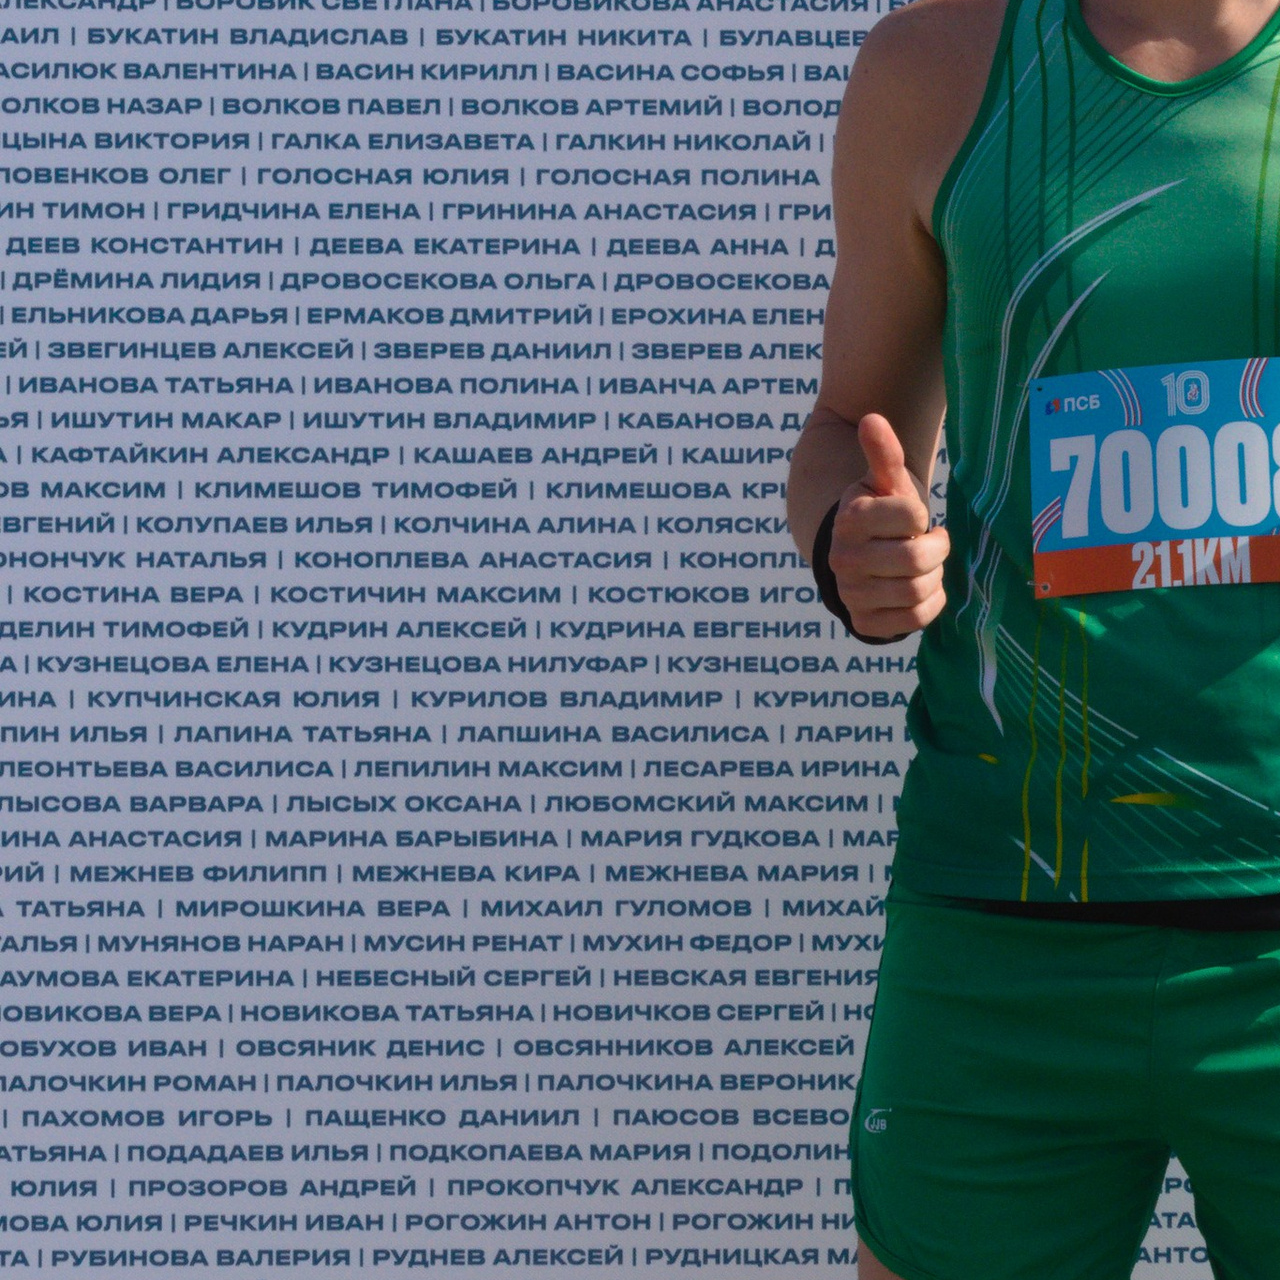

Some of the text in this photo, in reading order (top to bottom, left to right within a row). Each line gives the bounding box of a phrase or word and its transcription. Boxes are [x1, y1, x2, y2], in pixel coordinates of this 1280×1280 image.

[88, 28, 408, 47] БУКАТИН ВЛАДИСЛАВ
[223, 98, 440, 115] ВОЛКОВ ПАВЕЛ
[258, 168, 508, 185] ГОЛОСНАЯ ЮЛИЯ
[310, 238, 580, 256] ДЕЕВА ЕКАТЕРИНА
[13, 269, 154, 291] ДРЁМИНА
[161, 273, 260, 291] ЛИДИЯ
[308, 304, 592, 326] ЕРМАКОВ ДМИТРИЙ
[314, 378, 579, 394] ИВАНОВА ПОЛИНА
[1064, 394, 1101, 413] ПСБ
[32, 443, 389, 466] КАФТАЙКИН АЛЕКСАНДР
[137, 517, 372, 533] КОЛУПАЕВ ИЛЬЯ
[271, 586, 560, 603] КОСТИЧИН МАКСИМ
[38, 656, 309, 674] КУЗНЕЦОВА ЕЛЕНА
[174, 726, 431, 742] ЛАПИНА ТАТЬЯНА
[287, 796, 521, 812] ЛЫСЫХ ОКСАНА
[71, 866, 326, 882] МЕЖНЕВ ФИЛИПП
[98, 935, 343, 952] МУНЯНОВ НАРАН
[317, 966, 475, 986] НЕБЕСНЫЙ
[484, 966, 591, 986] СЕРГЕЙ
[241, 1005, 534, 1021] НОВИКОВА ТАТЬЯНА
[277, 1075, 517, 1091] ПАЛОЧКИН ИЛЬЯ
[128, 1145, 368, 1163] ПОДАДАЕВ ИЛЬЯ
[185, 1215, 383, 1231] РЕЧКИН ИВАН
